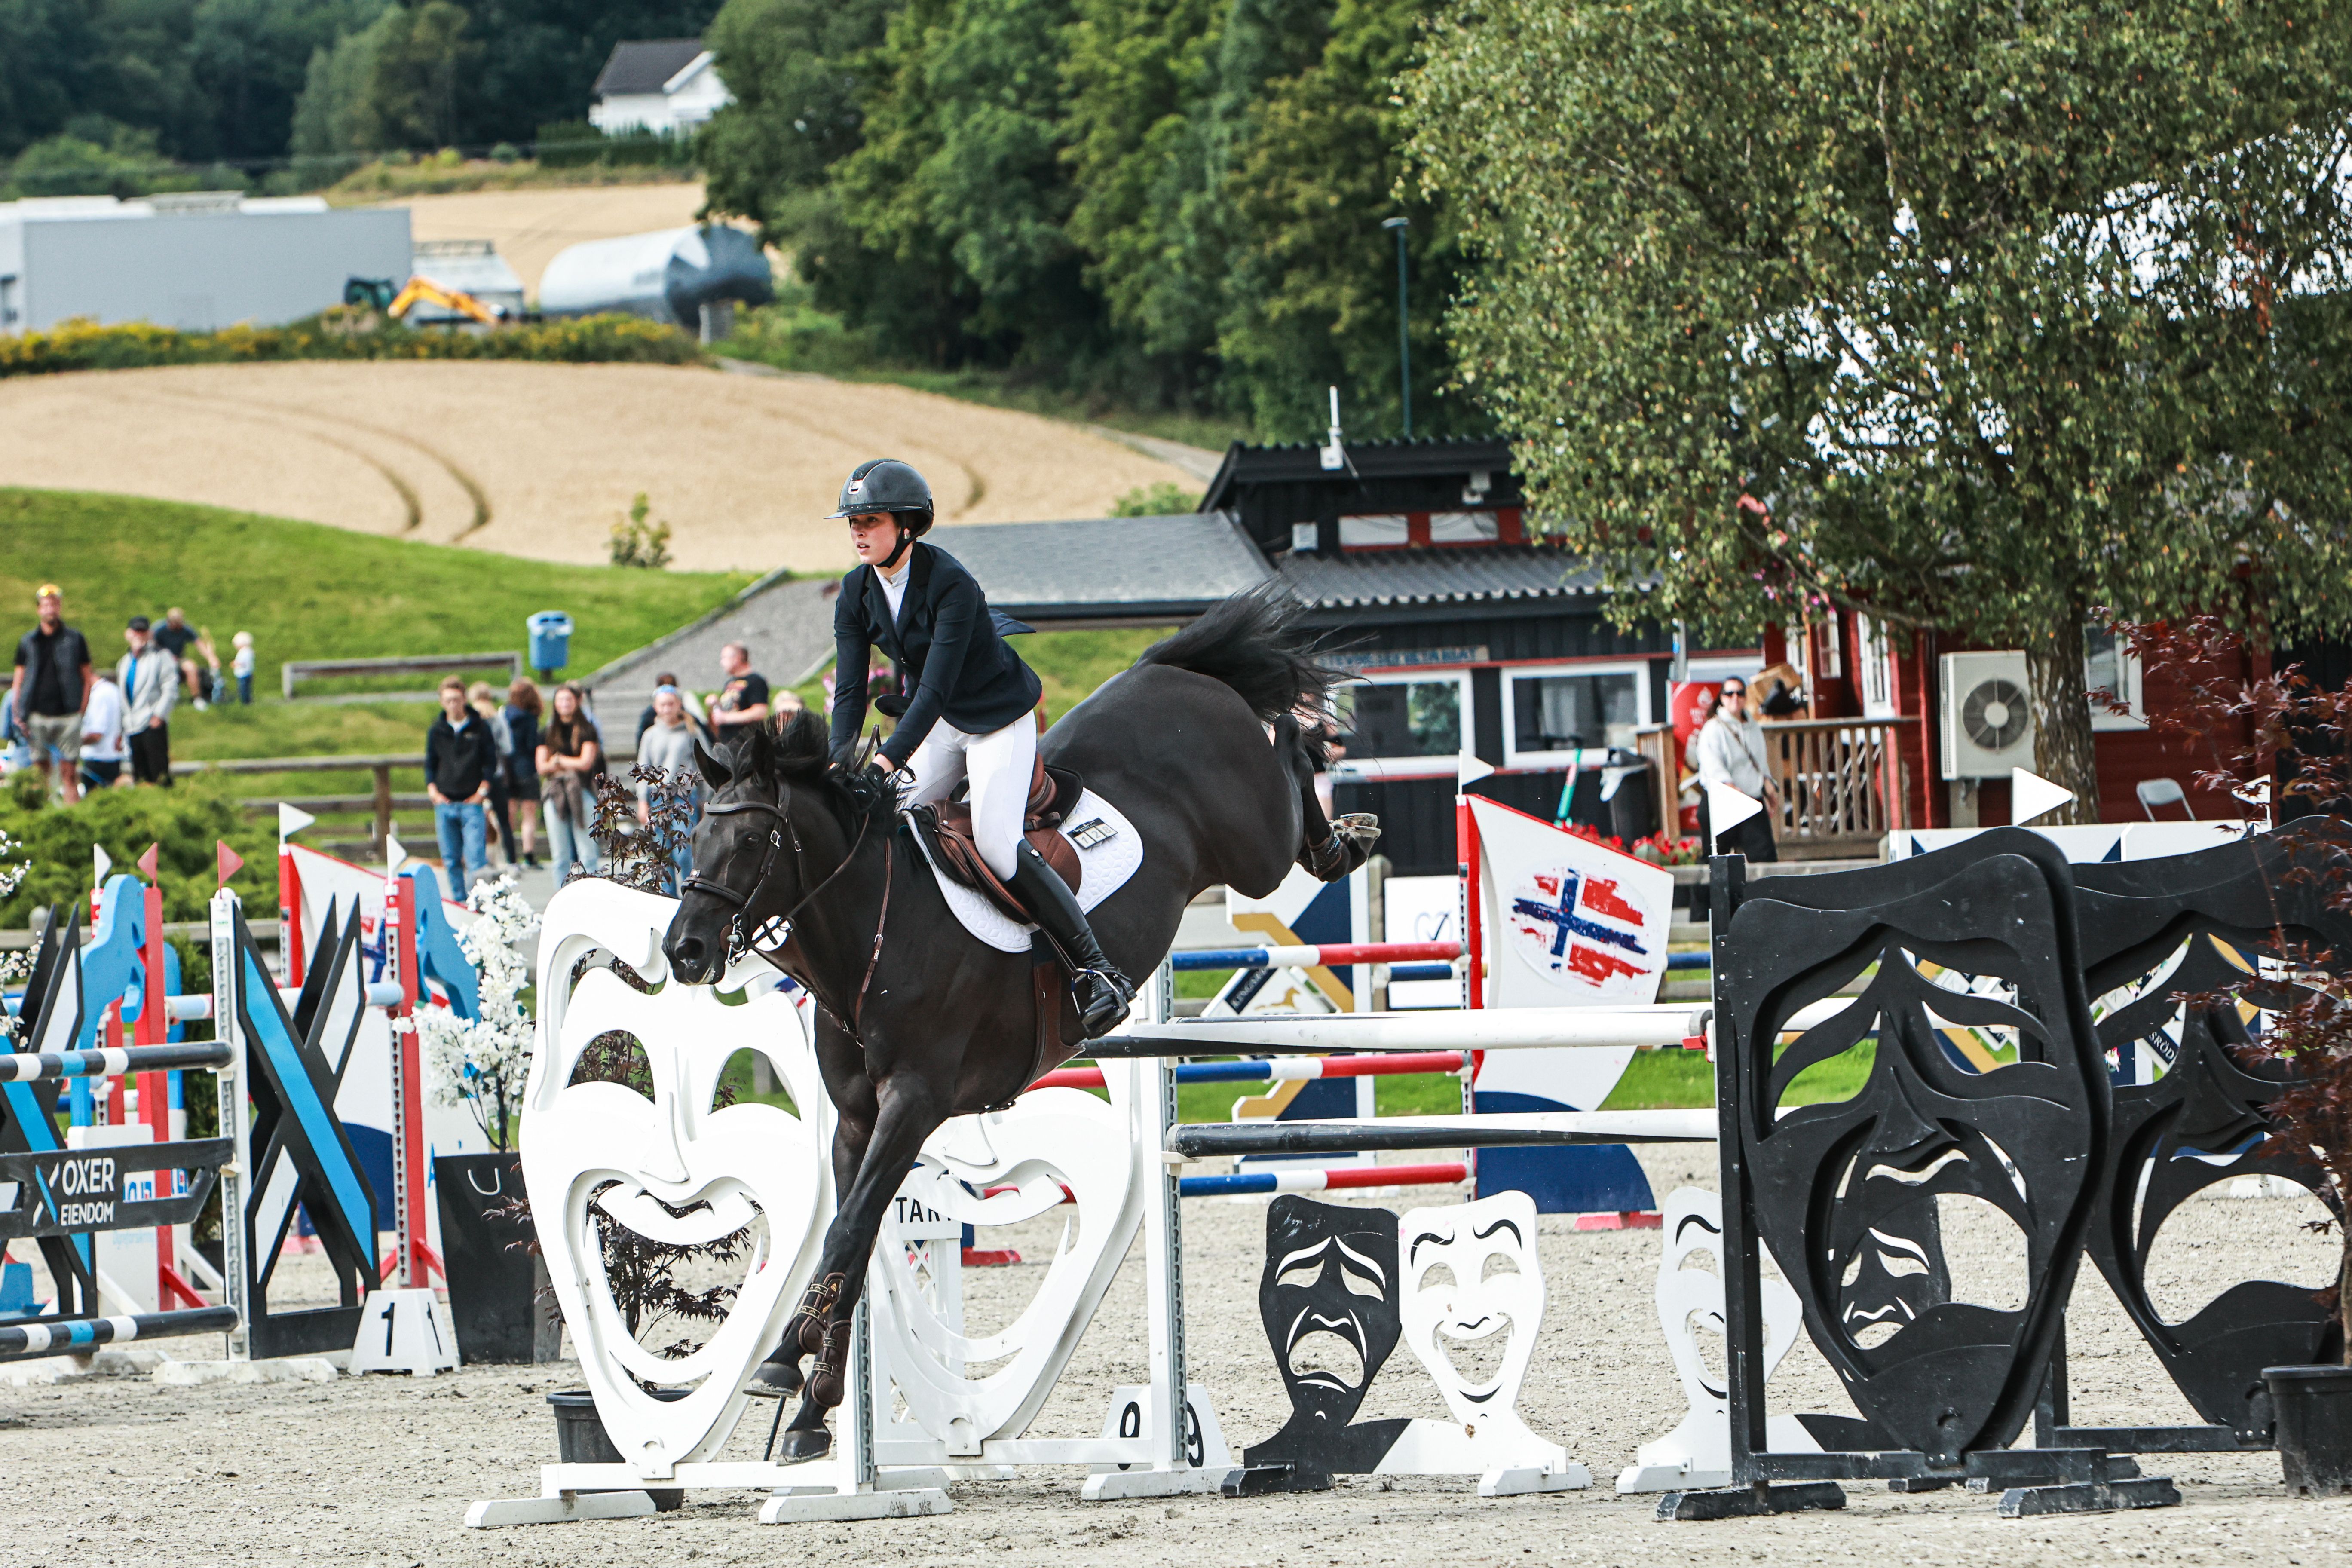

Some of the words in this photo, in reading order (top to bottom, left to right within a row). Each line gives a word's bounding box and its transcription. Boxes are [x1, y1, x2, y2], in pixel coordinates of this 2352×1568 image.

[1081, 826, 1112, 844] 128
[2148, 1031, 2174, 1060] SRÖD
[62, 1157, 115, 1196] OXER
[61, 1200, 115, 1226] EIENDOM
[381, 1302, 395, 1357] 1
